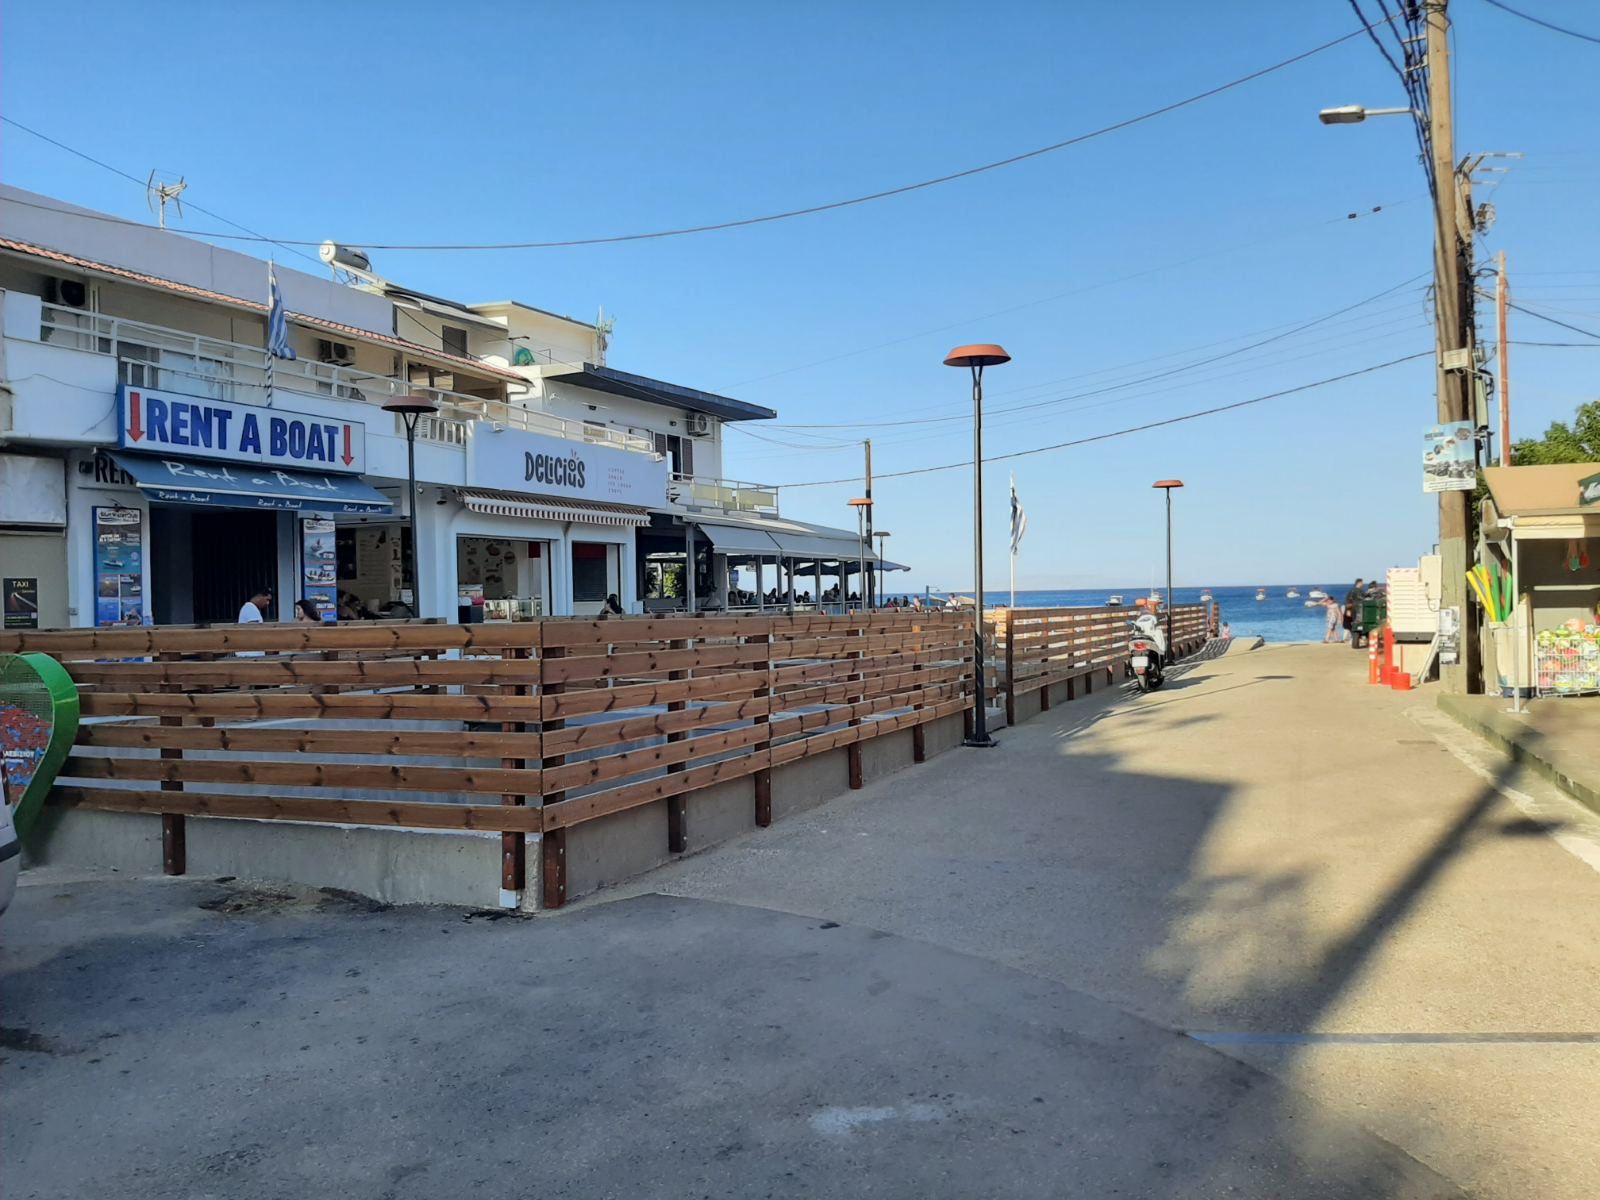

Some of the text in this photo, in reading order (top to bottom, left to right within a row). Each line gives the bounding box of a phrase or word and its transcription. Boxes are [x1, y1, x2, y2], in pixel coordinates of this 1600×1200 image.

[147, 398, 339, 462] RENT A BOAT
[161, 460, 238, 483] Rent
[271, 470, 339, 490] Boat
